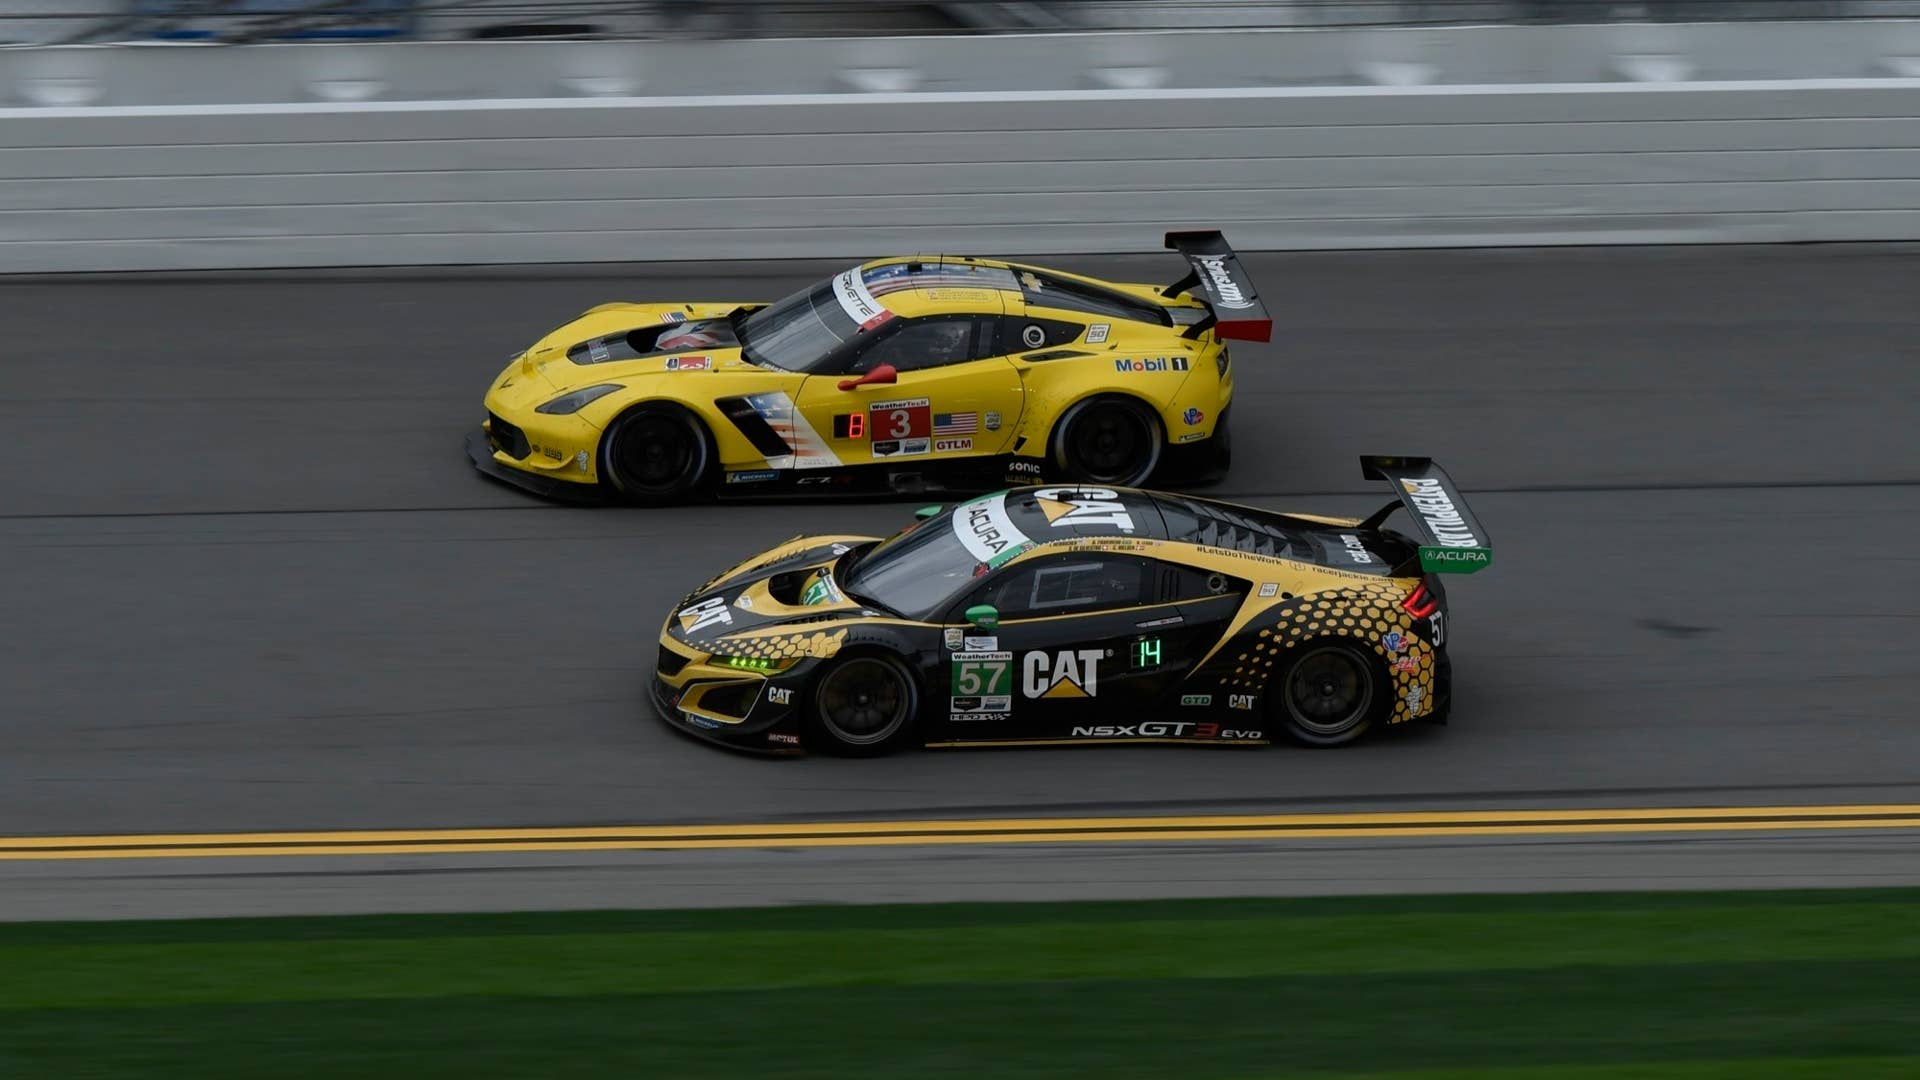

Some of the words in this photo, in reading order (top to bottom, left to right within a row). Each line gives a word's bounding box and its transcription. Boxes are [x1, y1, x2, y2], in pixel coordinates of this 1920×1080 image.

[1116, 358, 1167, 371] Mobil
[1173, 358, 1187, 370] 1
[890, 410, 911, 438] 3
[936, 440, 971, 450] GTLM
[1033, 487, 1135, 529] CAT
[969, 508, 1008, 553] ACURA
[1197, 546, 1282, 566] #LetsDoTheWork
[1436, 551, 1488, 561] ACURA
[678, 597, 732, 634] CAT
[1139, 639, 1161, 667] 14
[959, 662, 1006, 695] 57
[1023, 649, 1104, 699] CAT
[768, 687, 792, 705] CAT
[1183, 696, 1210, 704] GTD
[1229, 694, 1255, 710] CAT
[1221, 729, 1263, 738] EVO
